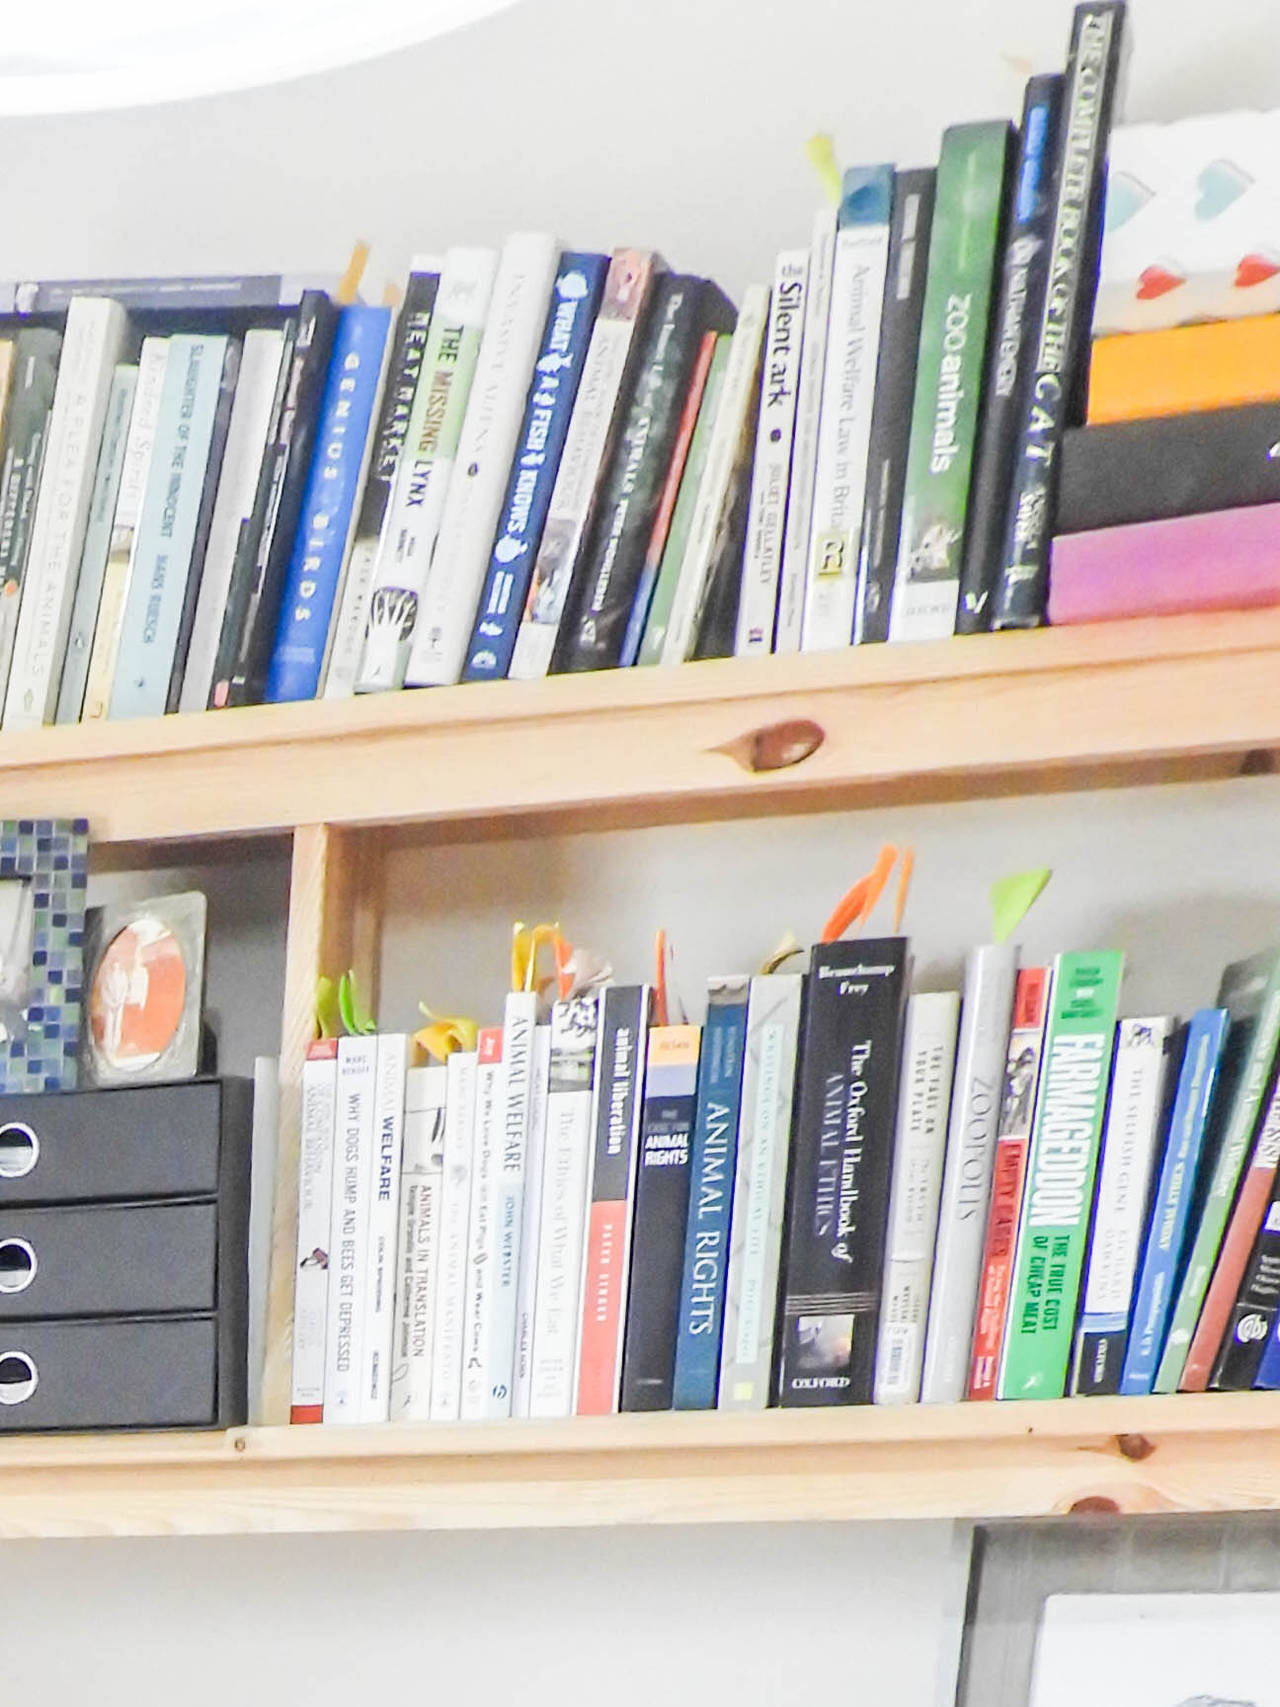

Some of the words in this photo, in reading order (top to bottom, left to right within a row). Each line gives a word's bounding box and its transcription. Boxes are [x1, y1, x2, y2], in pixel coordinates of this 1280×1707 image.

[768, 279, 803, 358] Silent
[845, 263, 871, 333] Animal
[436, 321, 465, 364] THE
[548, 297, 579, 353] WHAT
[540, 374, 560, 391] A
[765, 363, 796, 412] ark
[838, 335, 865, 412] Welfare
[417, 368, 454, 454] MISSING
[525, 405, 554, 452] FISH
[834, 414, 855, 456] Law
[1022, 370, 1063, 467] CAT
[404, 457, 433, 511] LYNX
[505, 466, 539, 535] KNOWS
[506, 1016, 529, 1087] ANIMAL
[612, 1026, 634, 1078] animal
[849, 1037, 872, 1077] The
[346, 1092, 361, 1121] WHY
[502, 1092, 525, 1172] WELFARE
[606, 1080, 630, 1155] liberation
[817, 1070, 847, 1153] ANIMAL
[843, 1079, 869, 1143] Oxford
[1025, 1029, 1107, 1233] FARMAGEDDON
[344, 1126, 360, 1162] DOGS
[377, 1115, 393, 1201] WELFARE
[644, 1133, 689, 1149] ANIMAL
[644, 1148, 689, 1166] RIGHTS
[696, 1101, 731, 1221] ANIMAL
[954, 1076, 995, 1223] ZOOPOLIS
[342, 1166, 358, 1203] HUMP
[835, 1146, 863, 1239] Handbook
[341, 1208, 356, 1234] AND
[414, 1183, 434, 1244] ANIMALS
[340, 1239, 355, 1270] BEES
[417, 1248, 429, 1262] IN
[829, 1240, 854, 1264] of
[1030, 1233, 1050, 1251] OF
[1051, 1232, 1071, 1260] THE
[339, 1274, 353, 1297] GET
[687, 1228, 721, 1336] RIGHTS
[1024, 1254, 1048, 1299] CHEAP
[1045, 1261, 1067, 1294] TRUE
[335, 1301, 352, 1372] DEPRESSED
[408, 1267, 432, 1358] TRANSLATION
[1019, 1301, 1041, 1336] MEAT
[1040, 1297, 1062, 1333] COST
